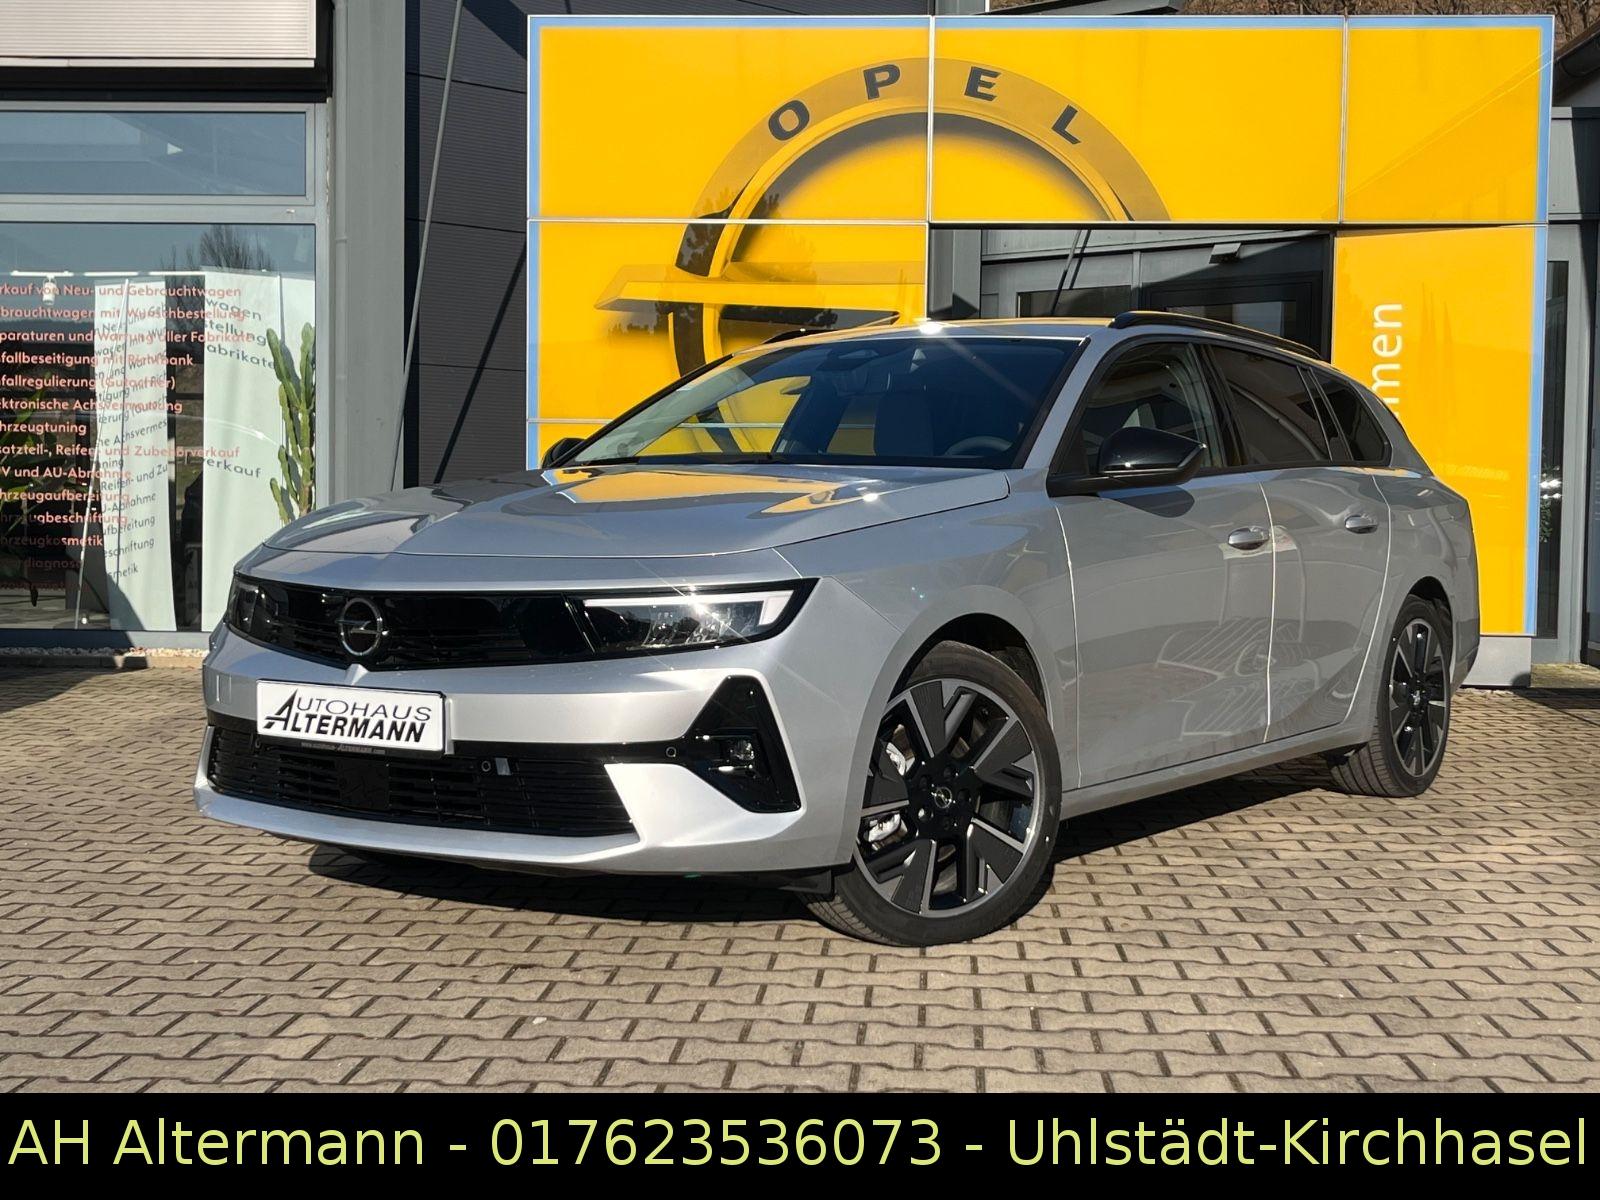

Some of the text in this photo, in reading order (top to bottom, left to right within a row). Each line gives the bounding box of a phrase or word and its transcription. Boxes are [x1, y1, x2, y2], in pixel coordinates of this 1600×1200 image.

[768, 63, 1081, 145] OPEL
[0, 351, 99, 368] fallbeseitigung
[1371, 303, 1403, 418] men
[0, 375, 97, 391] fallregulierung
[14, 465, 39, 479] und
[263, 689, 426, 743] ALTERMANN
[275, 689, 432, 722] AUTOHAUS
